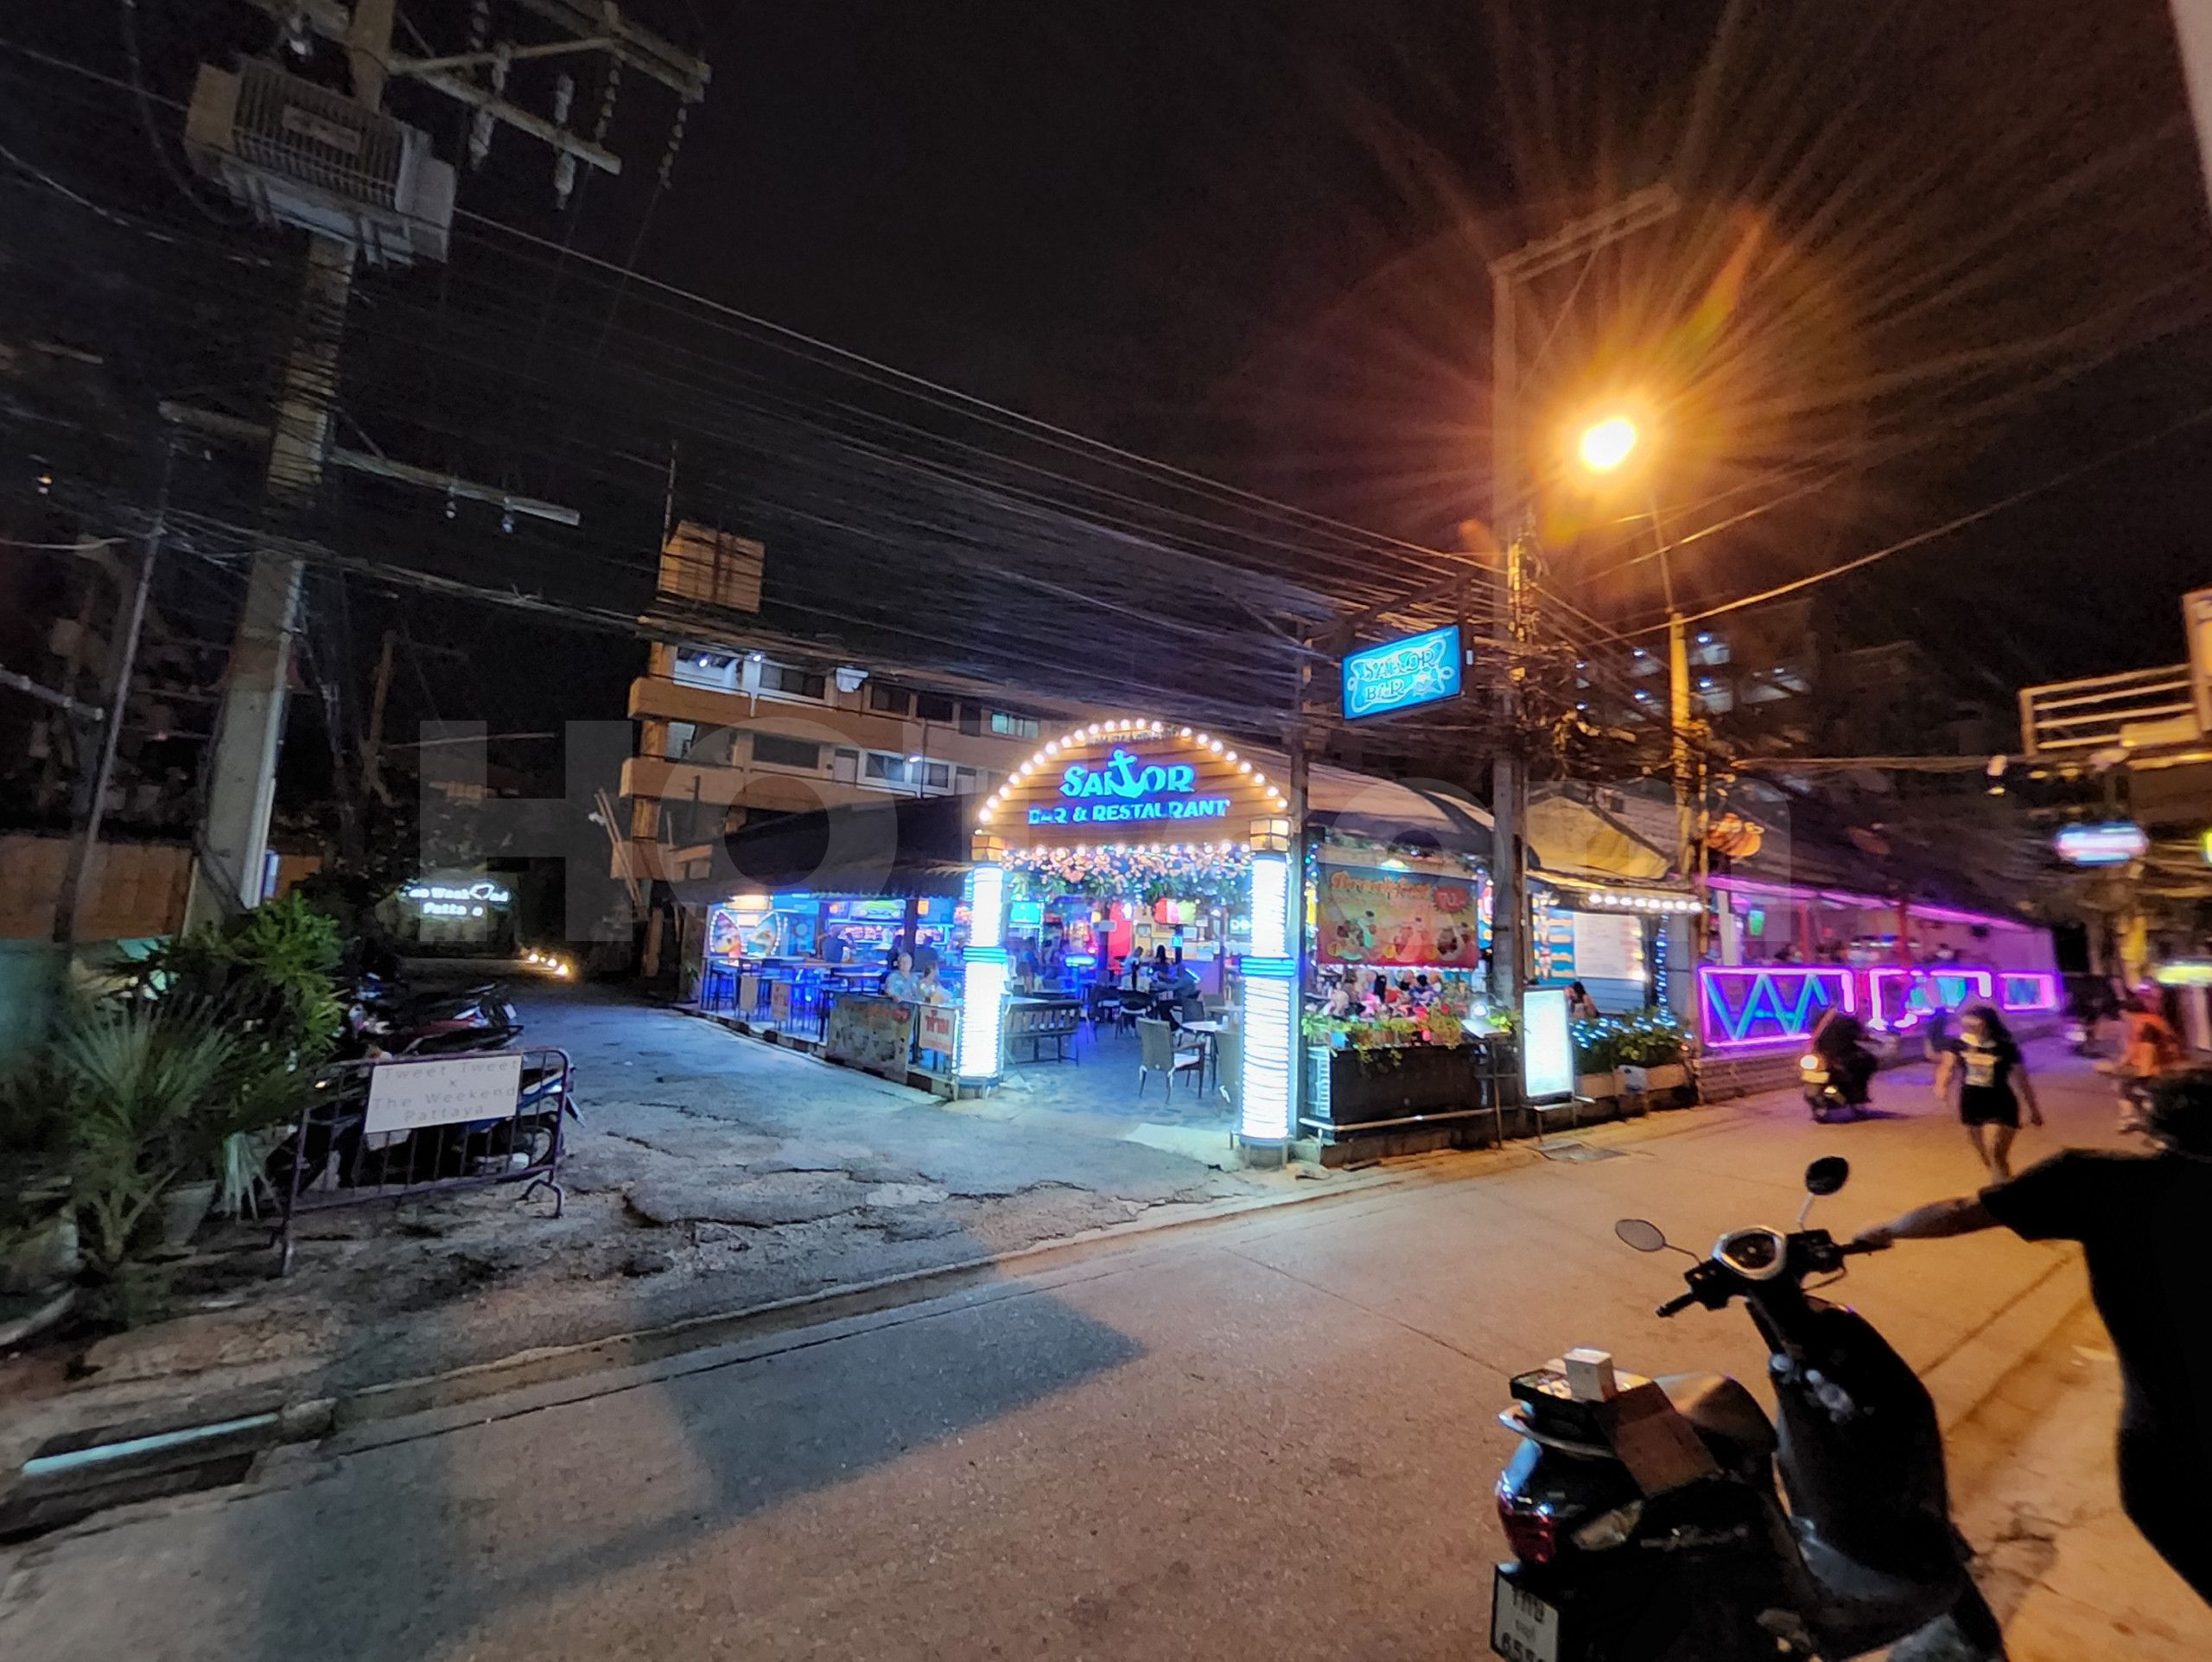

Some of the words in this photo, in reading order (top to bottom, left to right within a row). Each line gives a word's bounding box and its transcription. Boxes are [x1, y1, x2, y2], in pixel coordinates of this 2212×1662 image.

[1365, 679, 1405, 701] BAR
[382, 1066, 447, 1079] Tweet
[460, 1060, 518, 1073] Tweet
[372, 1097, 412, 1110] The
[424, 1086, 516, 1105] Weekend
[404, 1105, 485, 1123] Pattaya
